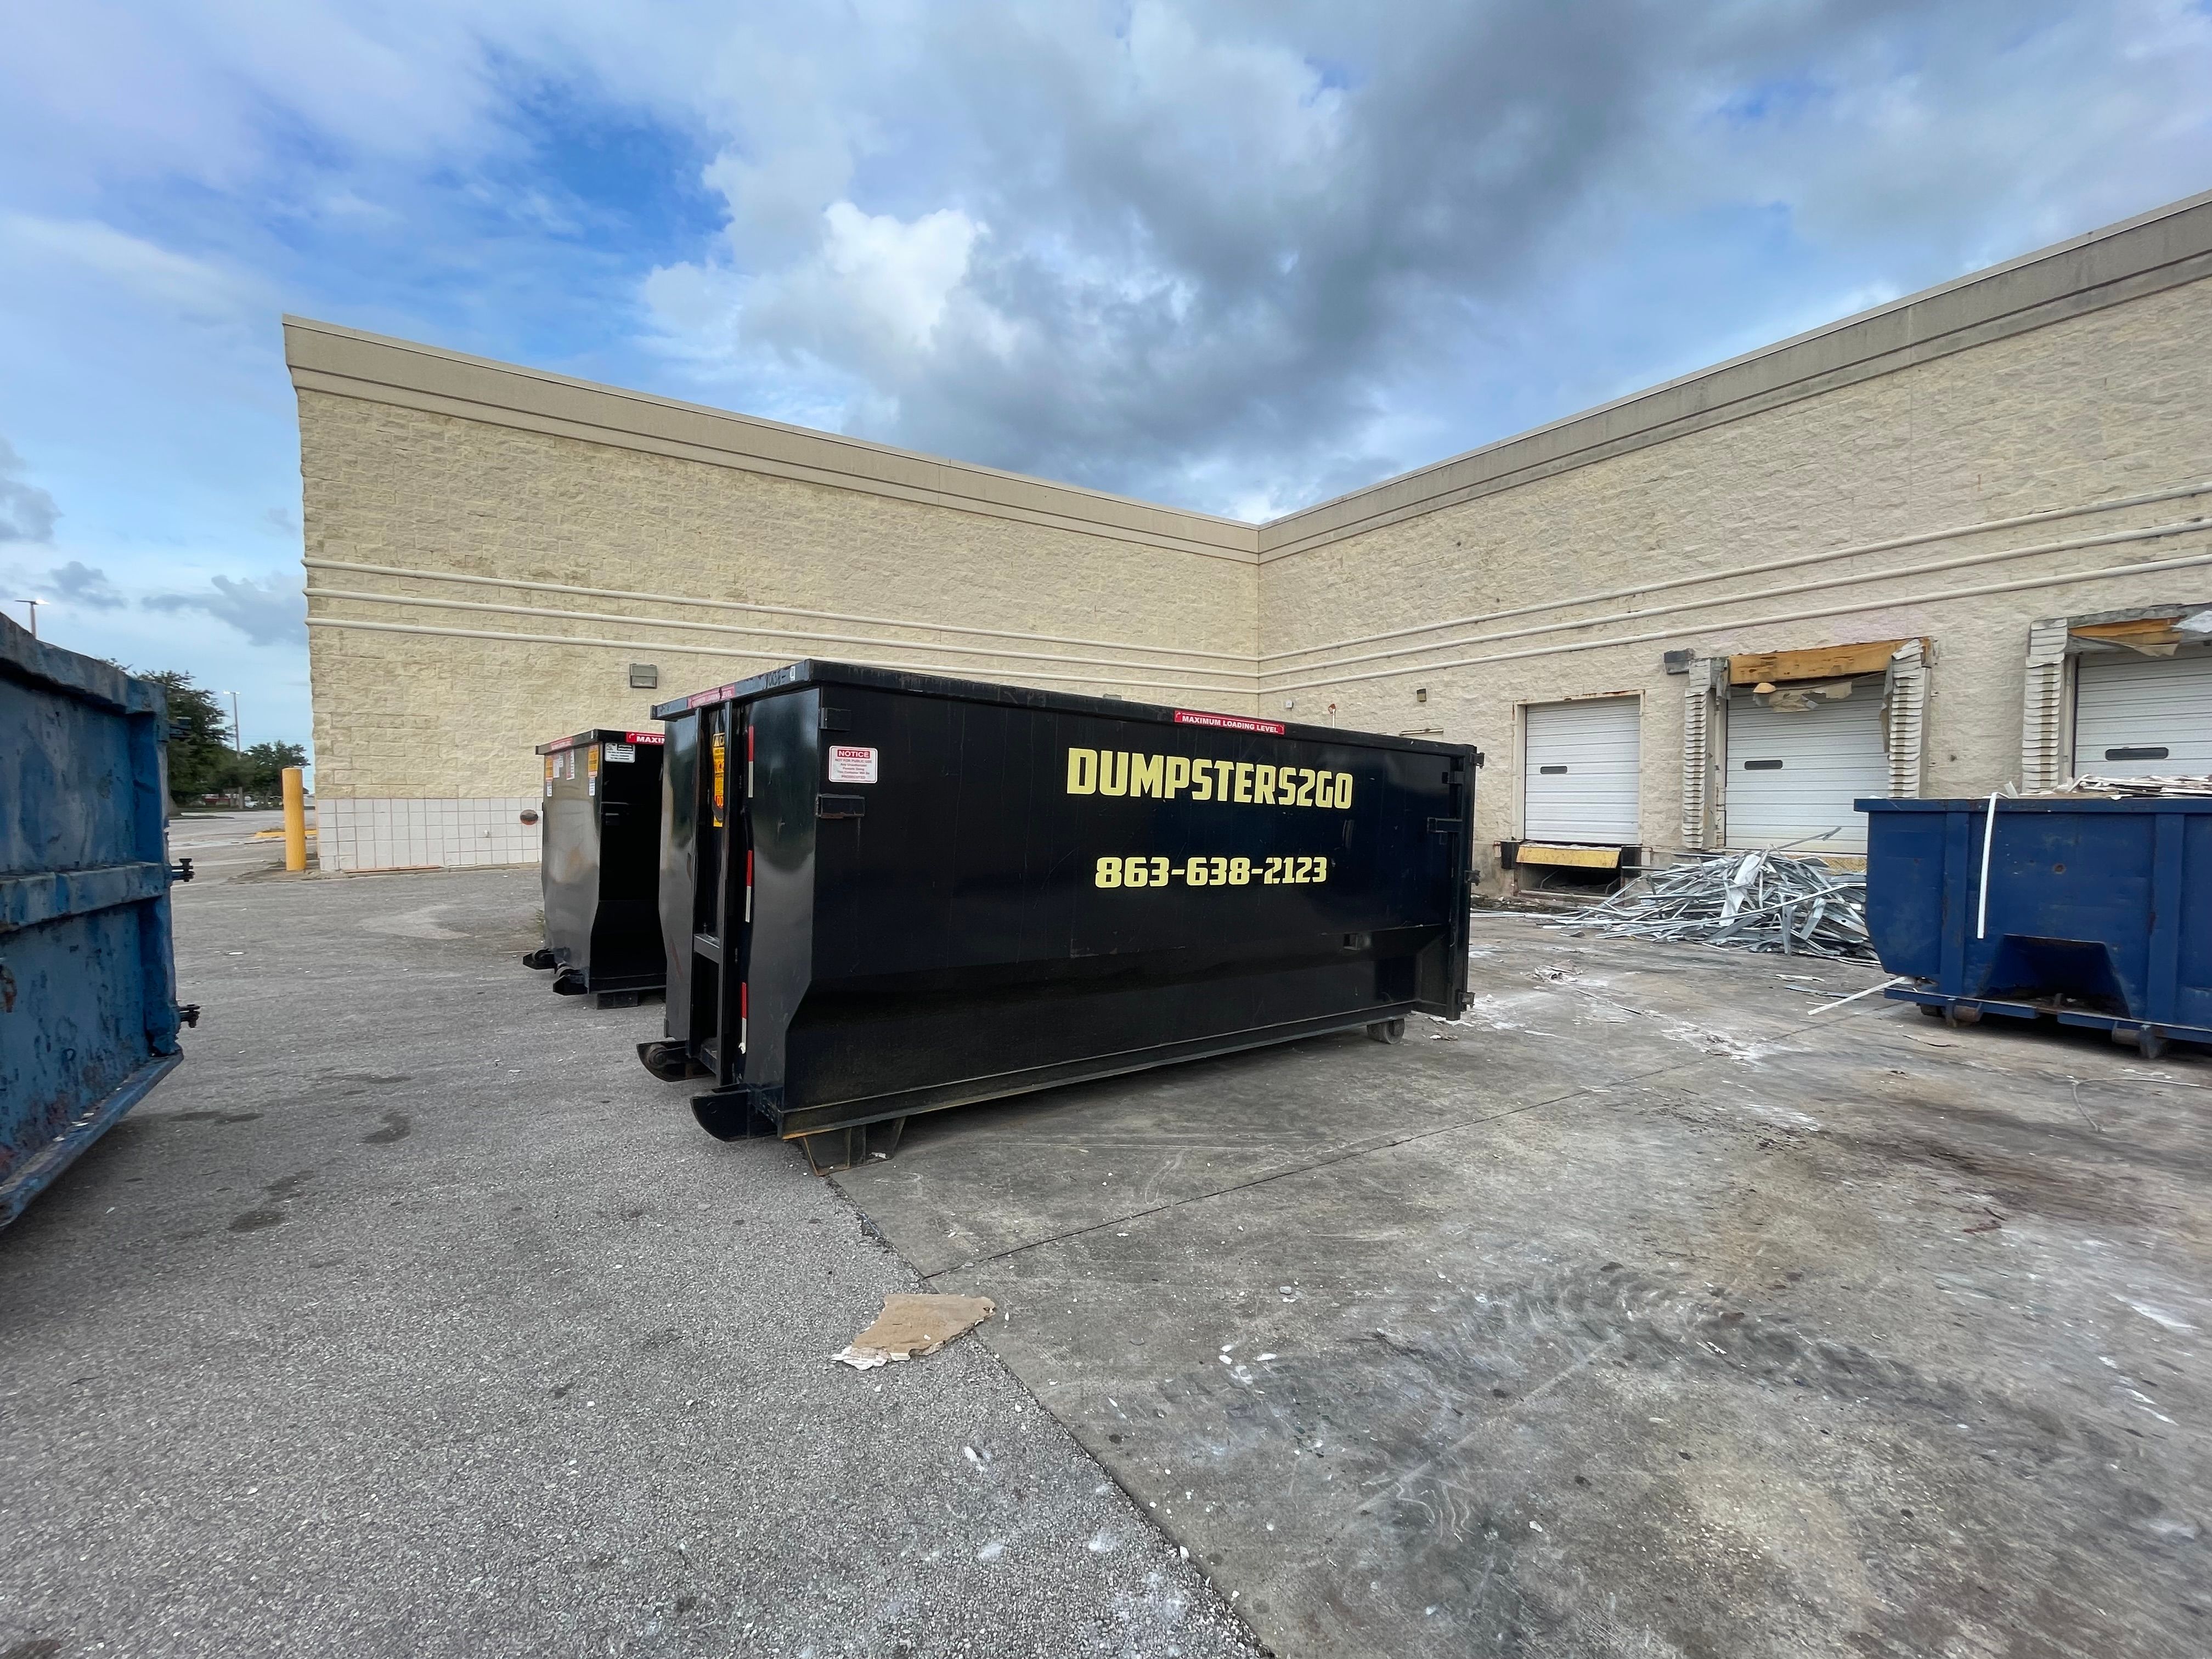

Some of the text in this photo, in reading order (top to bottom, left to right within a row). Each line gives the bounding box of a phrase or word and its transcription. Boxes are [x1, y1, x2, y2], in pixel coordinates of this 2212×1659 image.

[1182, 715, 1221, 726] MAXIMUM
[1223, 720, 1255, 730] LOADING
[1066, 747, 1353, 809] DUMPSTERS2GO
[1095, 857, 1327, 888] 863-638-2123
